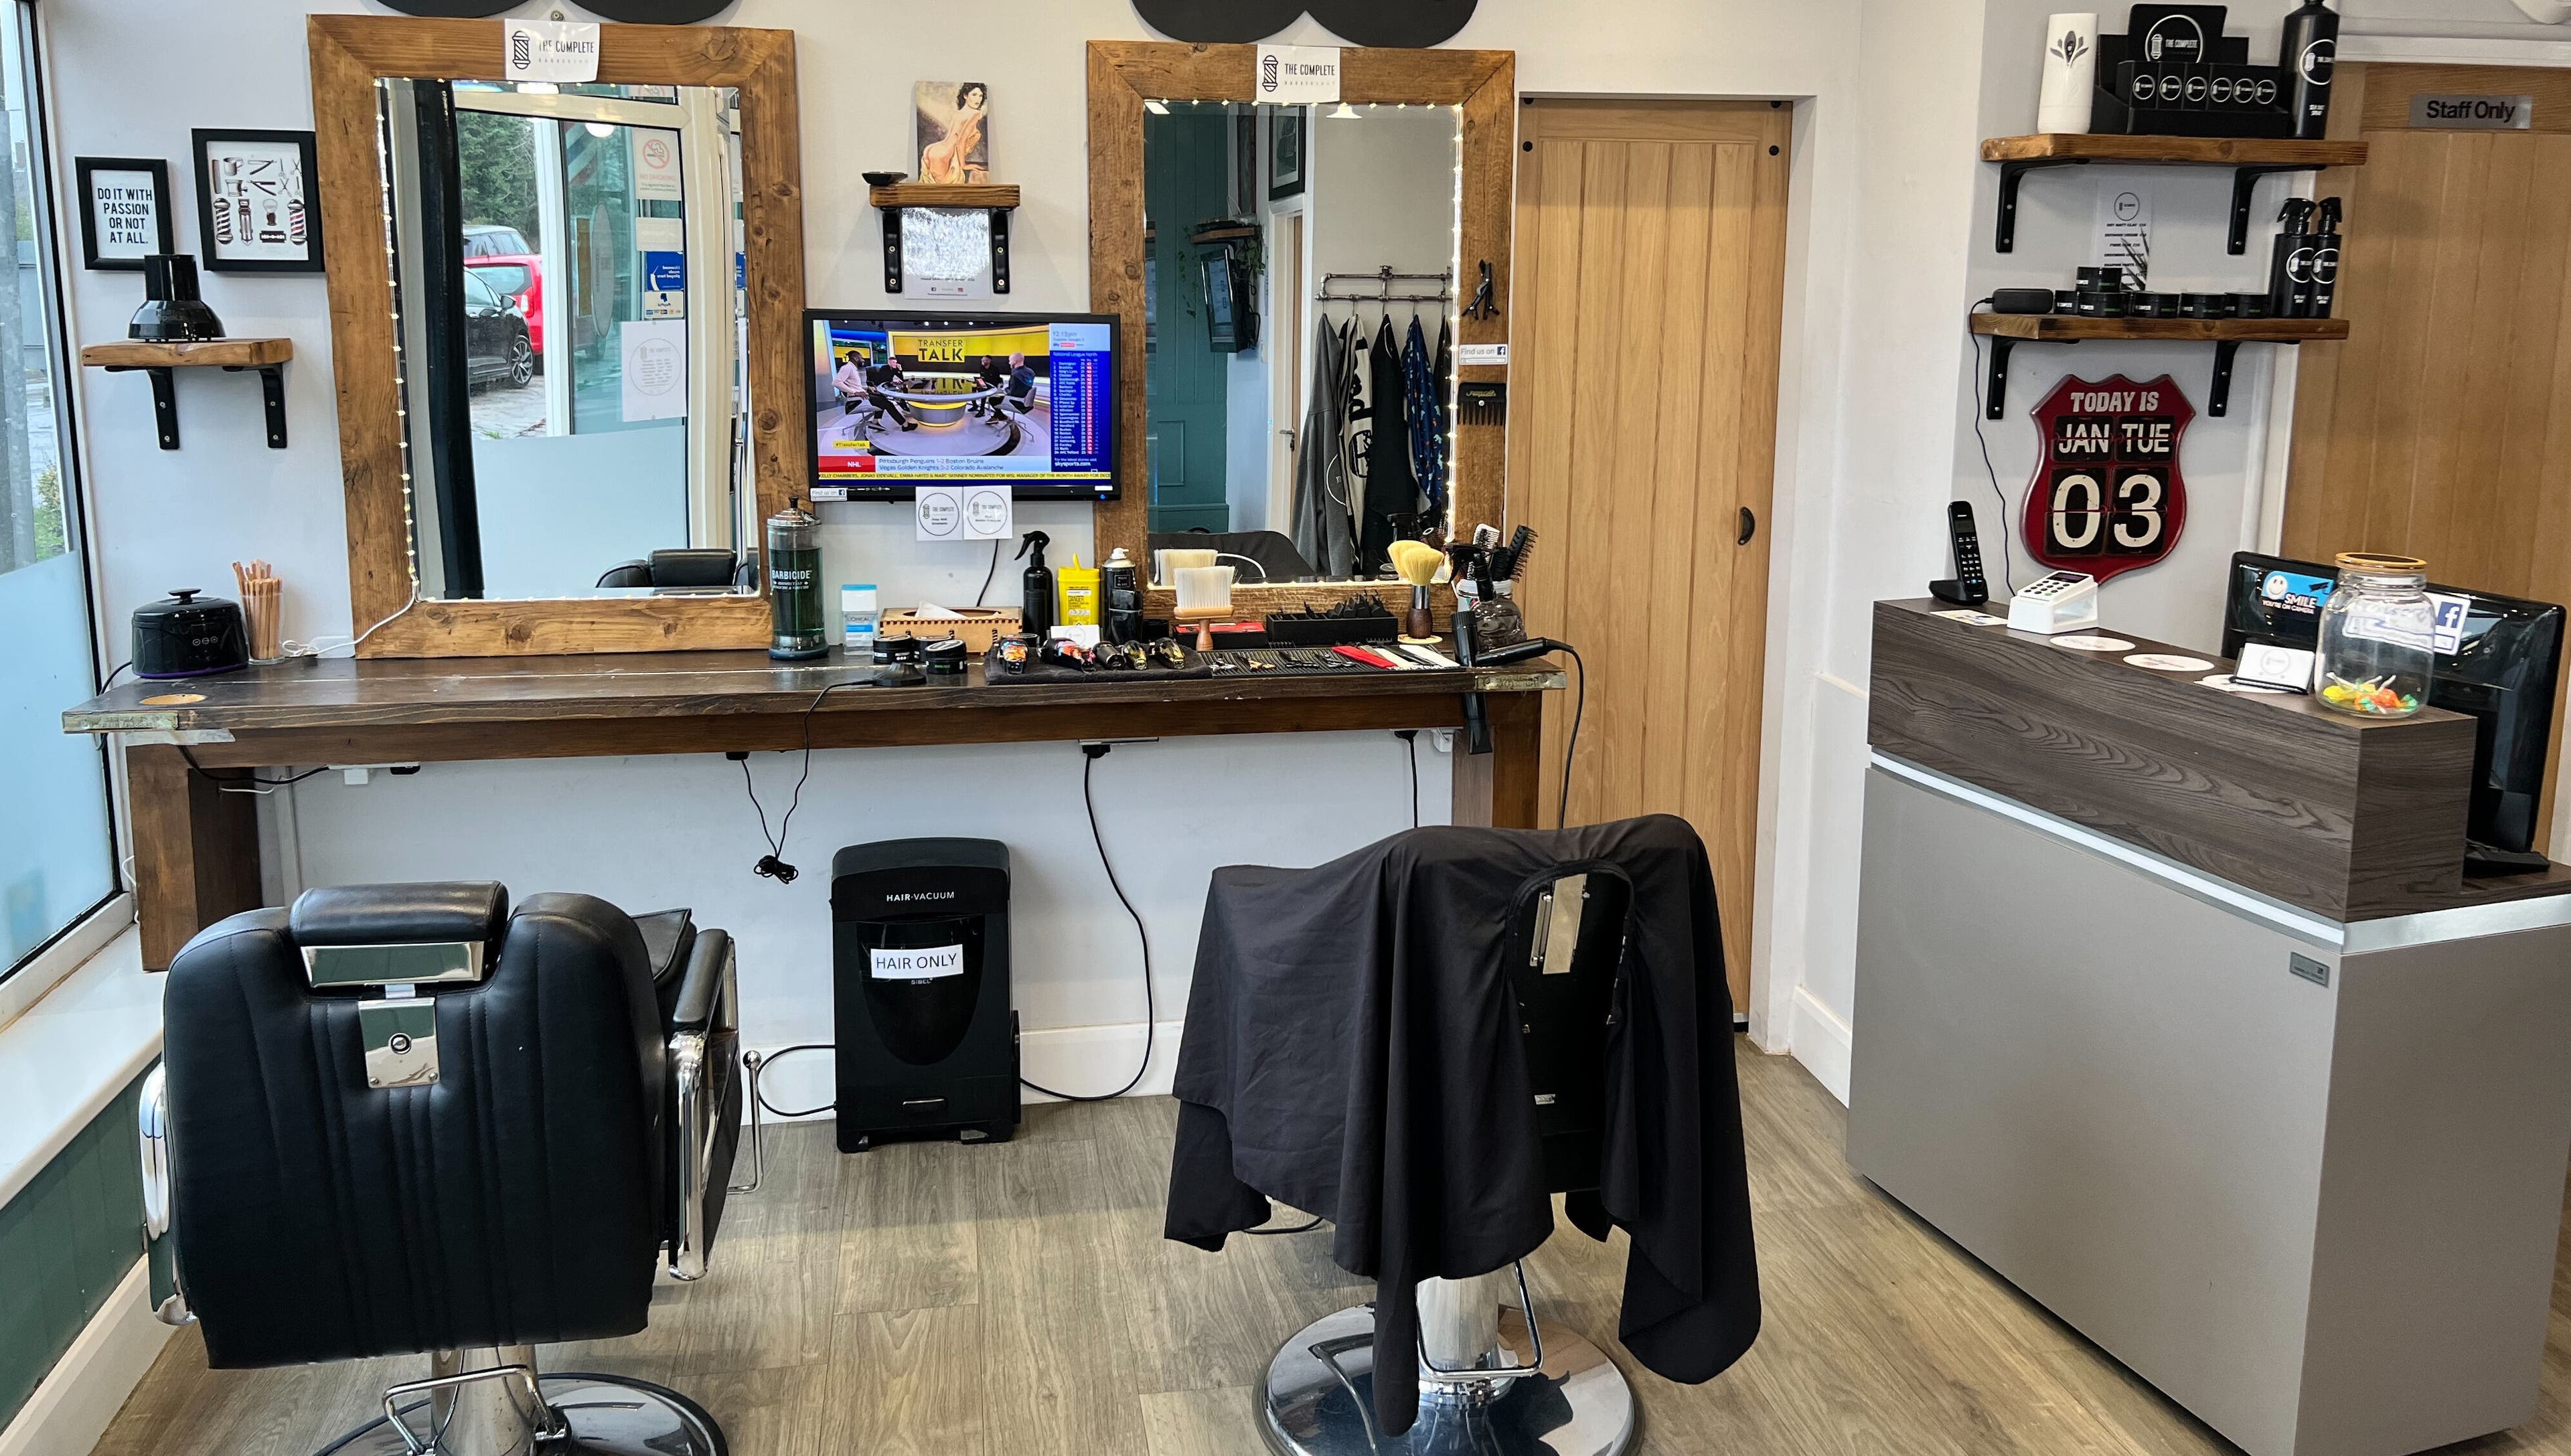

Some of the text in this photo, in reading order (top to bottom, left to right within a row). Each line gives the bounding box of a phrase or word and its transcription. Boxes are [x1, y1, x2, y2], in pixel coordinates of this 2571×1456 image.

[539, 39, 595, 54] THE COMPLETE
[1284, 64, 1336, 76] THE COMPLETE
[2426, 100, 2516, 123] Staff Only
[97, 188, 153, 201] DO IT WITH
[103, 203, 149, 215] PASSION
[108, 217, 145, 230] OR NOT
[110, 232, 148, 244] AT ALL.
[919, 348, 963, 361] TALK
[1460, 347, 1476, 355] Find
[2070, 392, 2159, 412] TODAY IS
[2059, 424, 2171, 453] JAN TUE
[771, 570, 811, 580] BARBICIDE
[2262, 600, 2282, 609] YOU'RE
[2291, 605, 2315, 615] CAMERA
[2284, 593, 2317, 609] SMILE
[876, 953, 957, 969] HAIR ONLY
